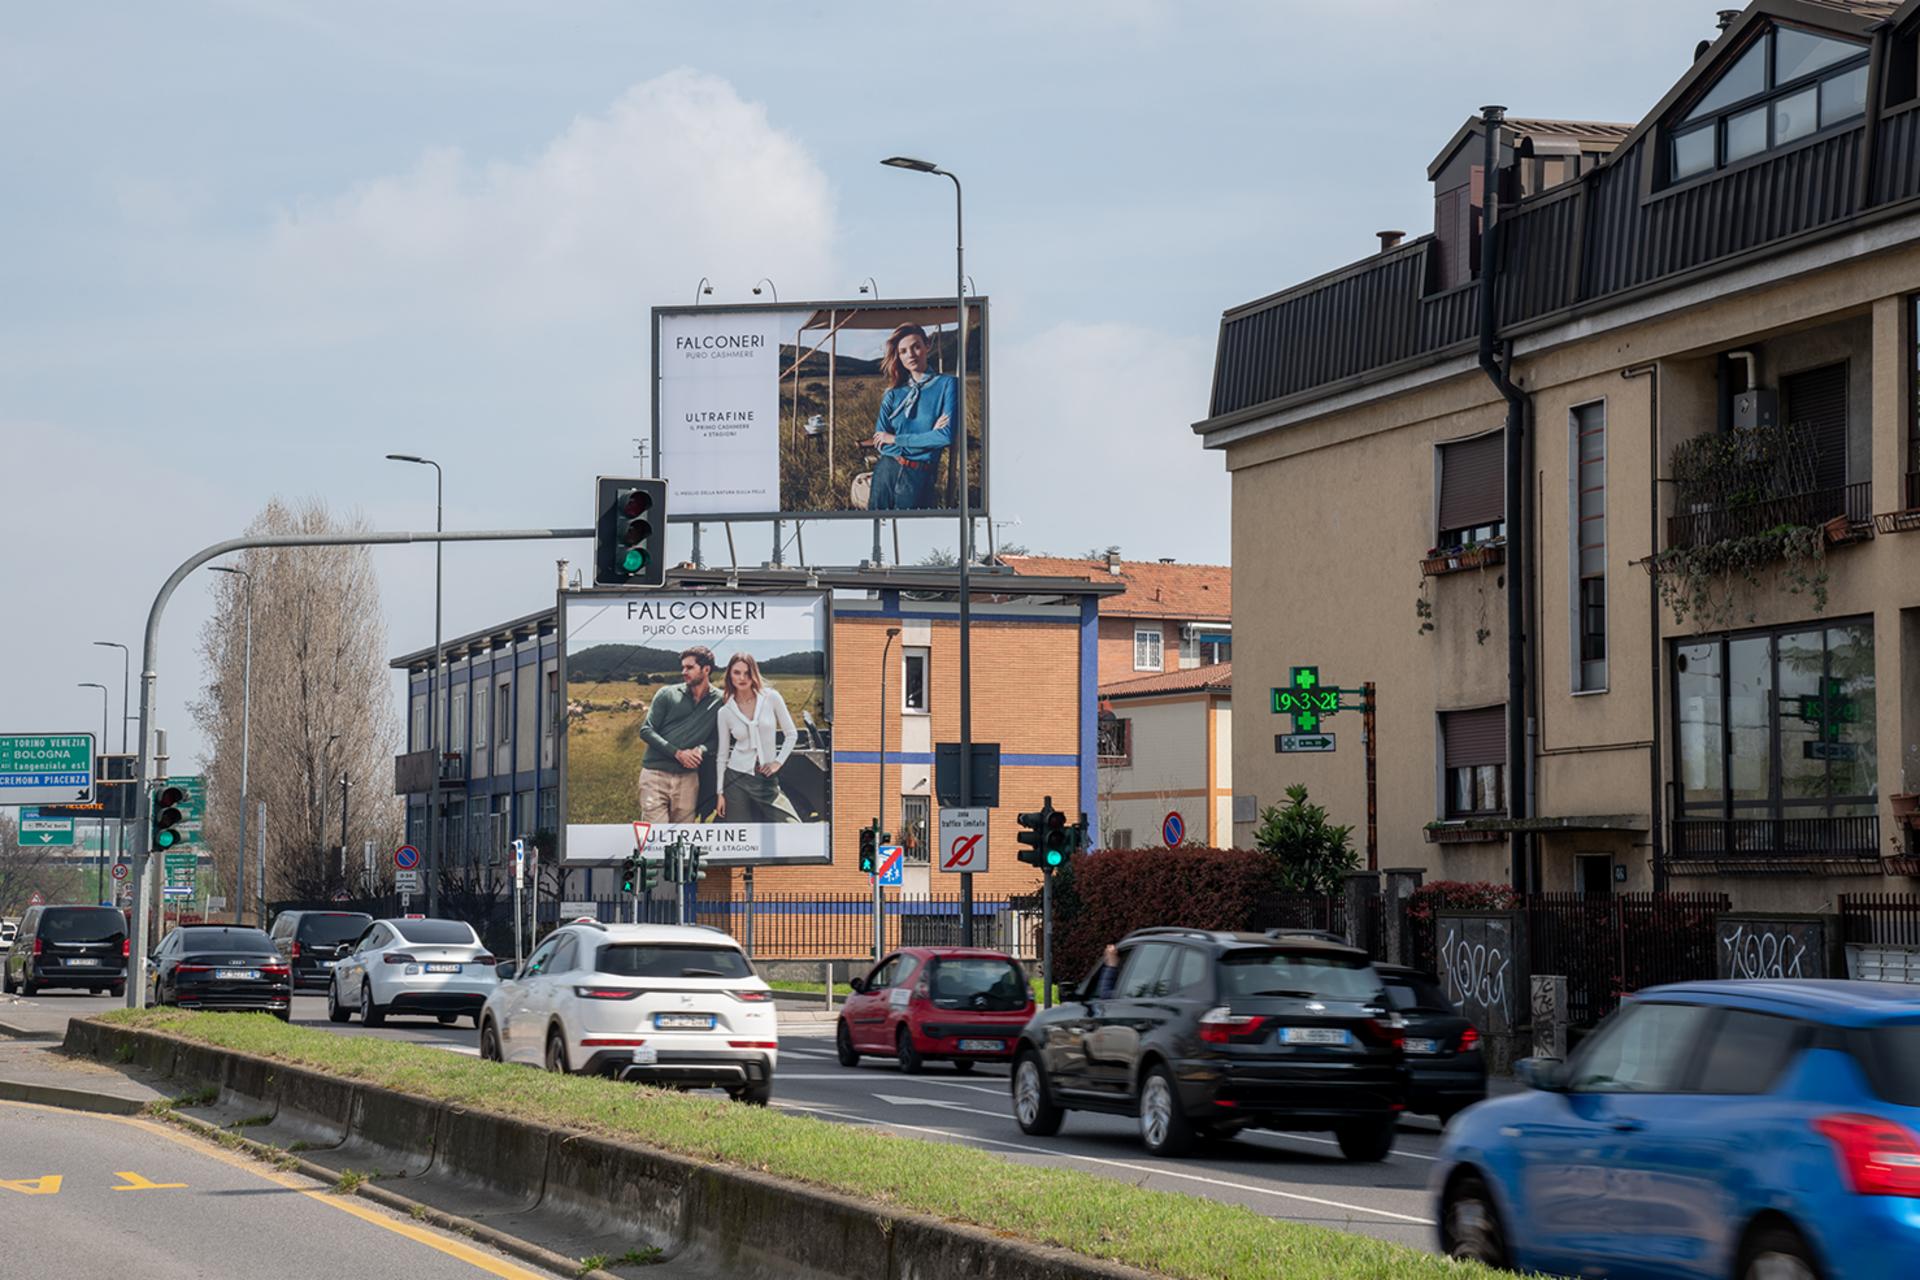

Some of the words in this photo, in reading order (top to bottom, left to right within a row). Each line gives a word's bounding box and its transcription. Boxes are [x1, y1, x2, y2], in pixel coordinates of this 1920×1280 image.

[676, 334, 764, 349] FALCONERI
[686, 351, 708, 359] PURO
[710, 350, 753, 359] CASHMERE
[685, 411, 754, 422] ULTRAFINE
[627, 601, 765, 620] FALCONERI
[642, 625, 676, 636] PURO
[681, 624, 750, 635] CASHMERE
[14, 739, 46, 748] TORINO
[50, 738, 87, 747] VENEZIA
[14, 750, 71, 759] BOLOGNA
[14, 762, 67, 771] tangenziale
[71, 762, 86, 770] est
[0, 776, 40, 785] CREMONA
[44, 775, 87, 784] PIACENZA
[941, 820, 962, 828] traffico
[963, 820, 986, 828] limitato
[646, 829, 747, 843] ULTRAFINE
[115, 867, 125, 875] 50
